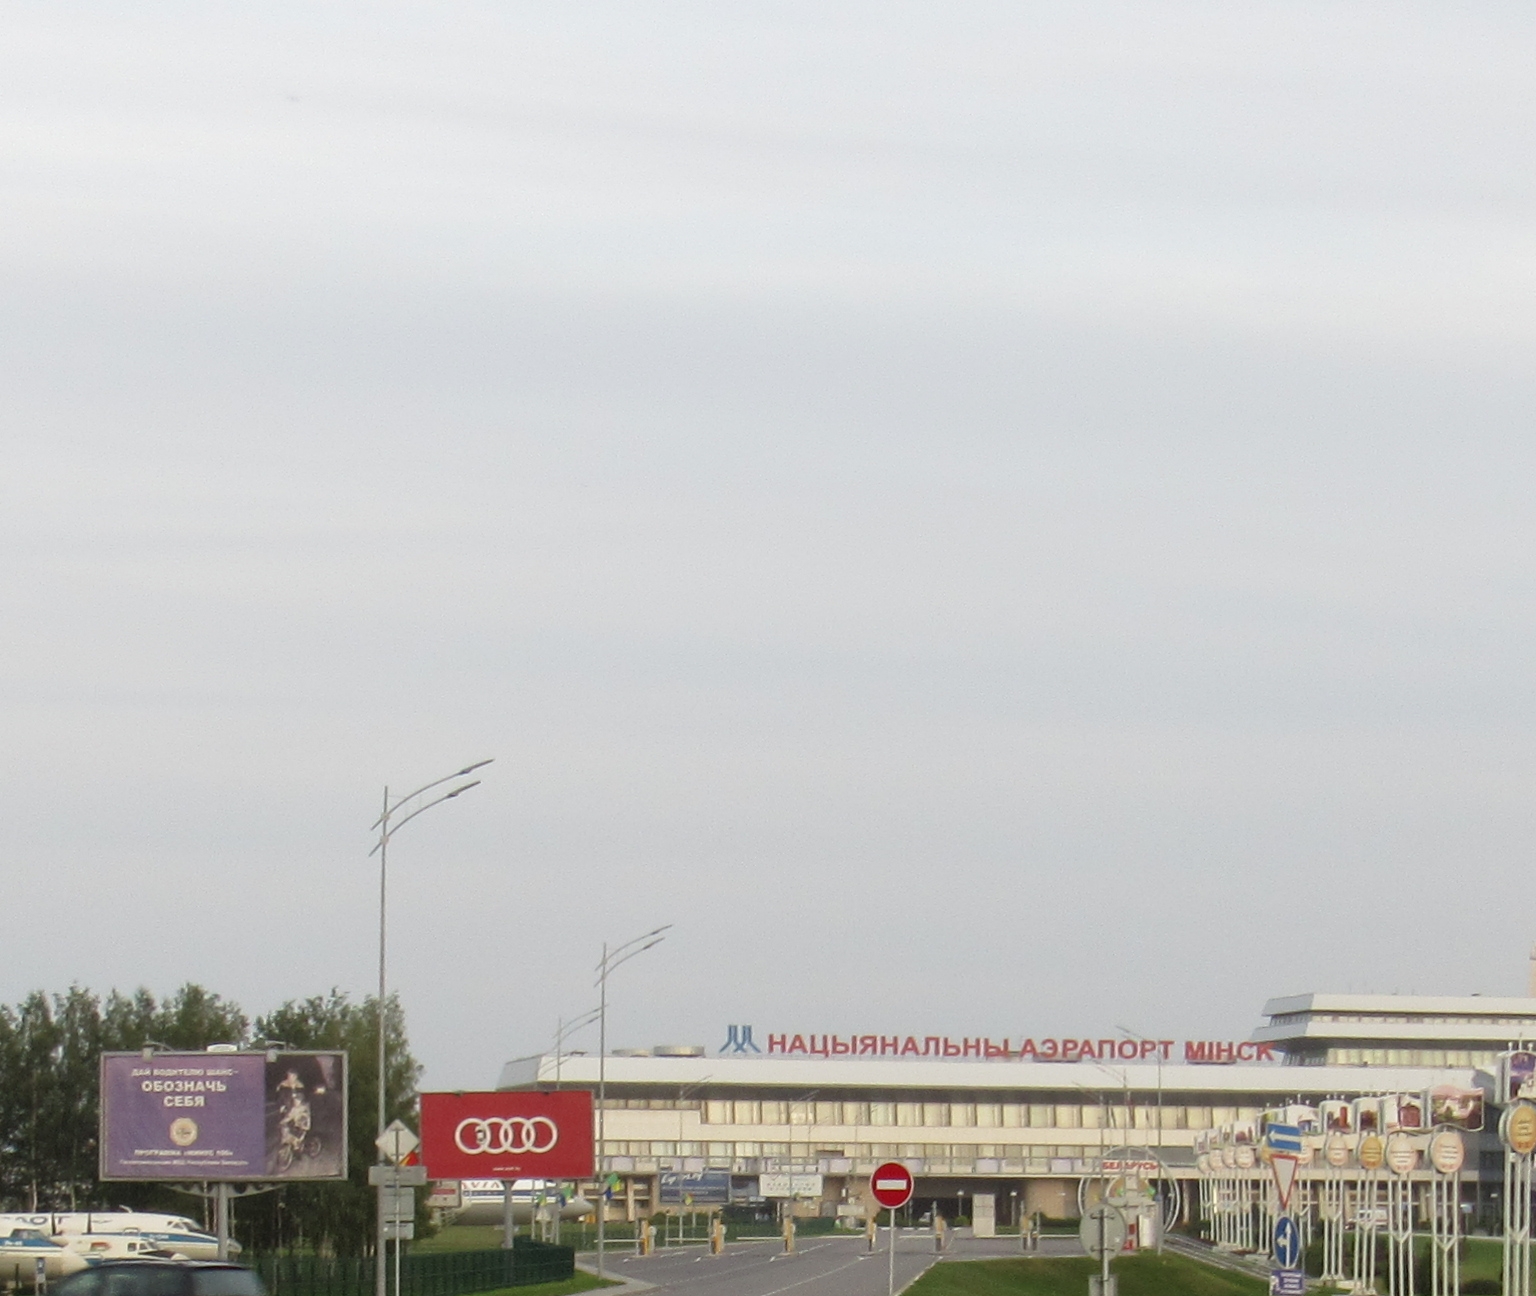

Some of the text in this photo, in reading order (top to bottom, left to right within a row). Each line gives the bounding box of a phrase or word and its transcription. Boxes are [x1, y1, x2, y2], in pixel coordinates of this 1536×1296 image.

[768, 1033, 1277, 1061] НАЦЫЯНАЛЬНЫ АЭРАПОРТ МІНСК
[141, 1080, 227, 1092] ОБОЗНАЧЬ
[163, 1095, 205, 1107] СЕБЯ
